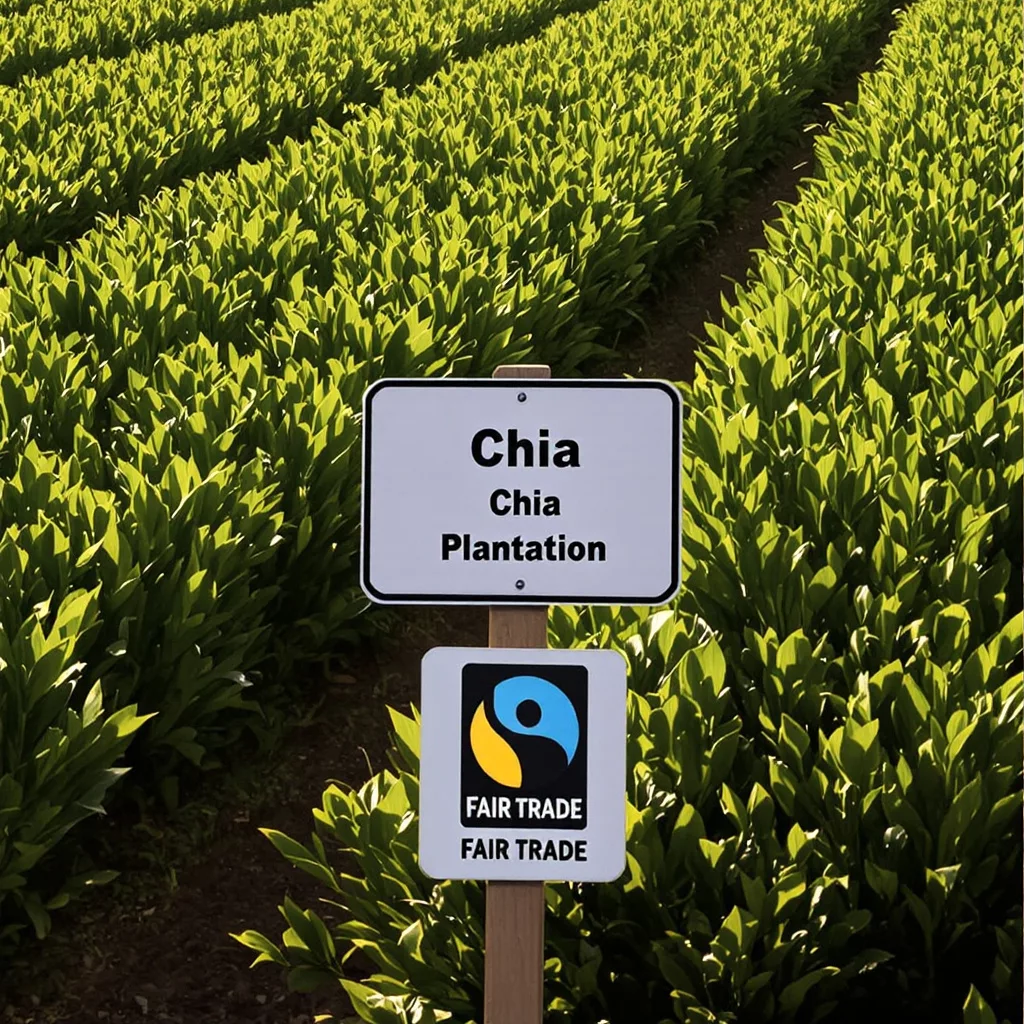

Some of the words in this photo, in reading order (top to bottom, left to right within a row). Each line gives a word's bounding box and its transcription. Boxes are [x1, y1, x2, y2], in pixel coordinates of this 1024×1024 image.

[470, 428, 582, 468] Chia
[489, 488, 561, 517] Chia
[441, 533, 607, 562] Plantation
[466, 796, 511, 819] FAIR
[515, 797, 583, 820] TRADE
[461, 837, 510, 861] FAIR
[515, 838, 588, 862] TRADE
